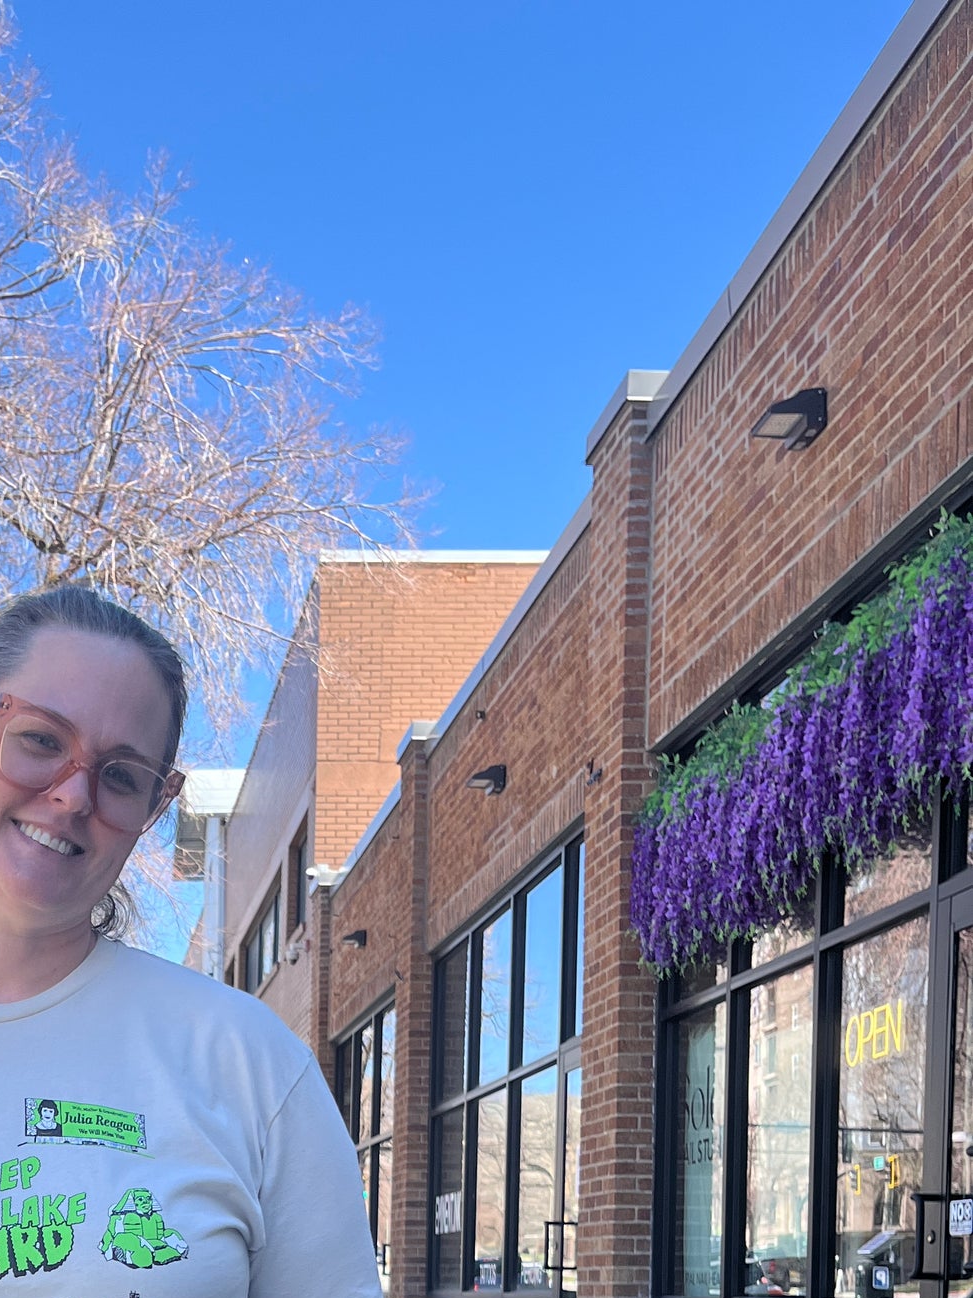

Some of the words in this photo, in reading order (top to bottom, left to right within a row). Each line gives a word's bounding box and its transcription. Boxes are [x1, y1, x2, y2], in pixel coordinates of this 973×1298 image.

[845, 998, 903, 1068] OPEN
[63, 1111, 94, 1125] Julia
[96, 1115, 138, 1133] Reagan
[88, 1128, 101, 1136] Will
[101, 1129, 114, 1137] Miss
[1, 1192, 87, 1229] LAKE
